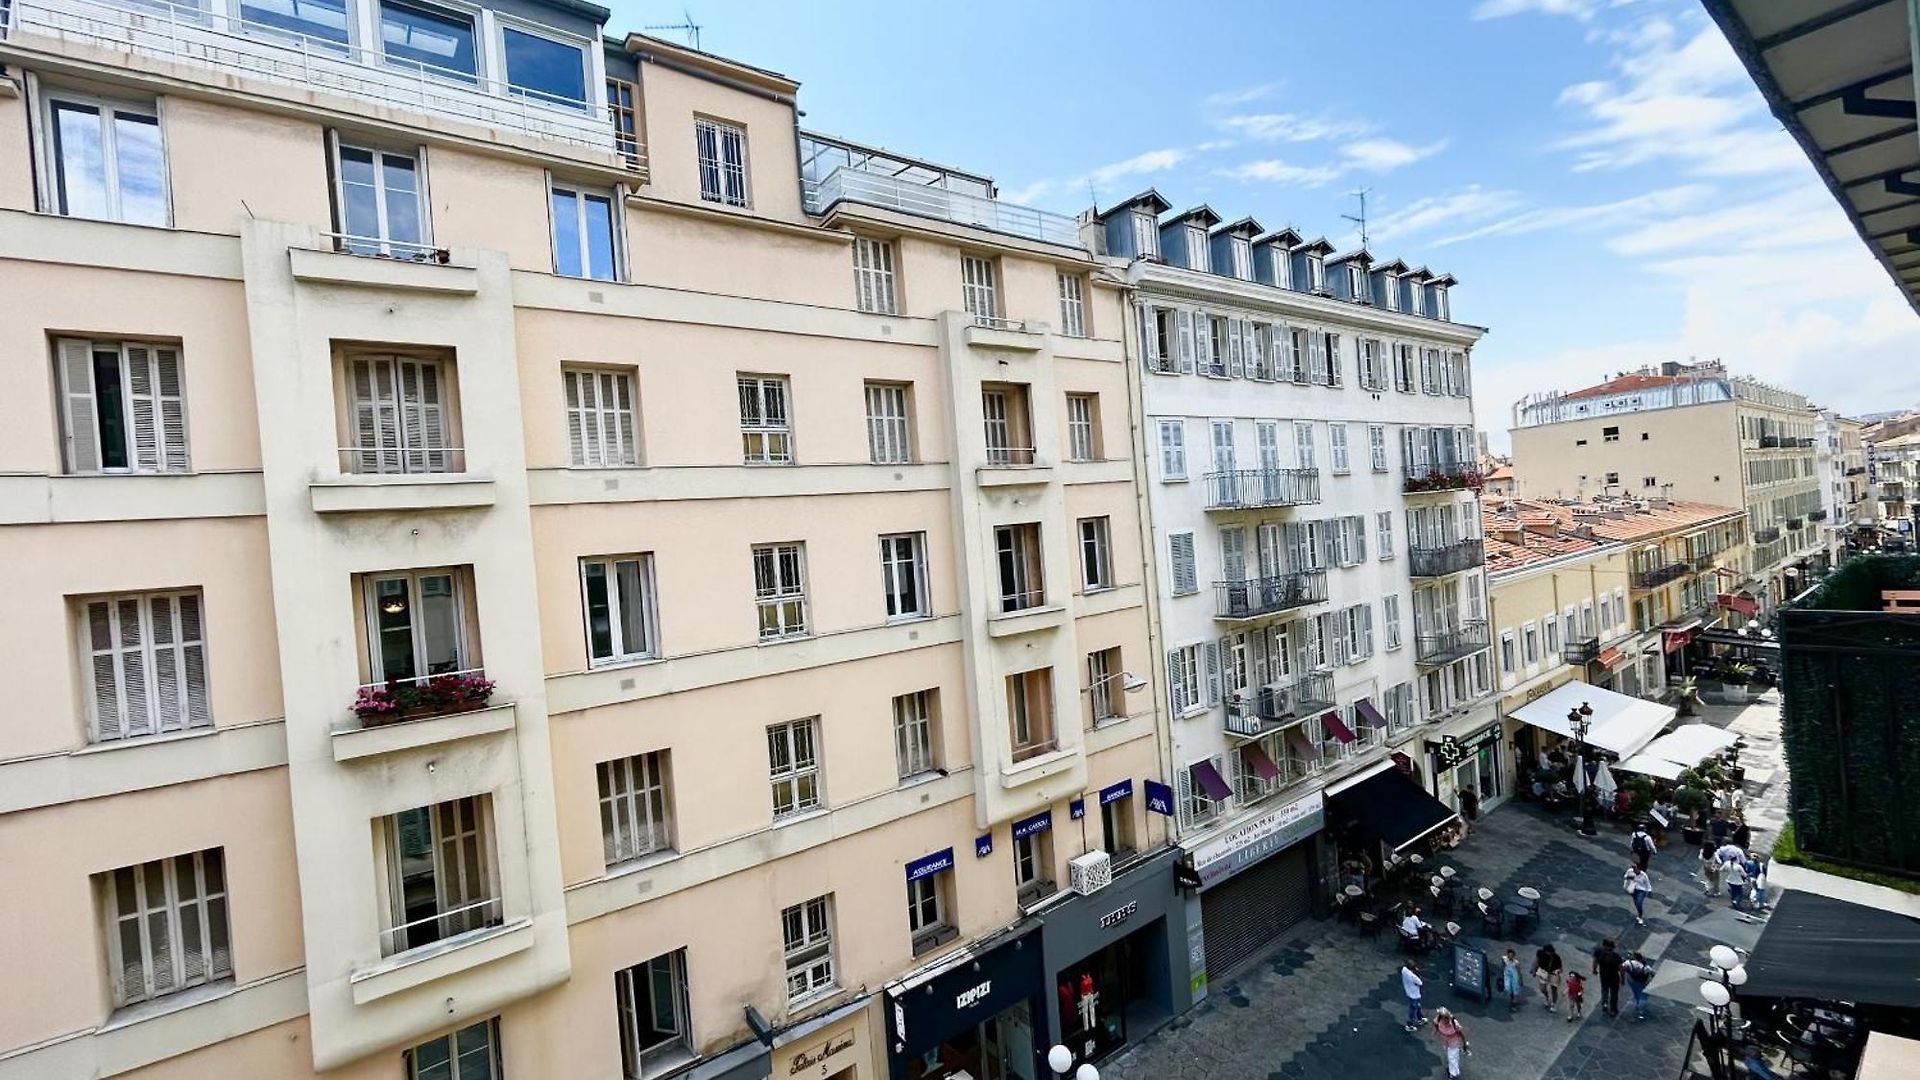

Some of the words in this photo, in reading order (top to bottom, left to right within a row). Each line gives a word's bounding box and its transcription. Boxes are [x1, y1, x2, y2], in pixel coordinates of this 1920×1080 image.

[1149, 797, 1167, 813] AXA
[977, 844, 991, 856] AXA
[955, 980, 992, 1009] IZIPIZI
